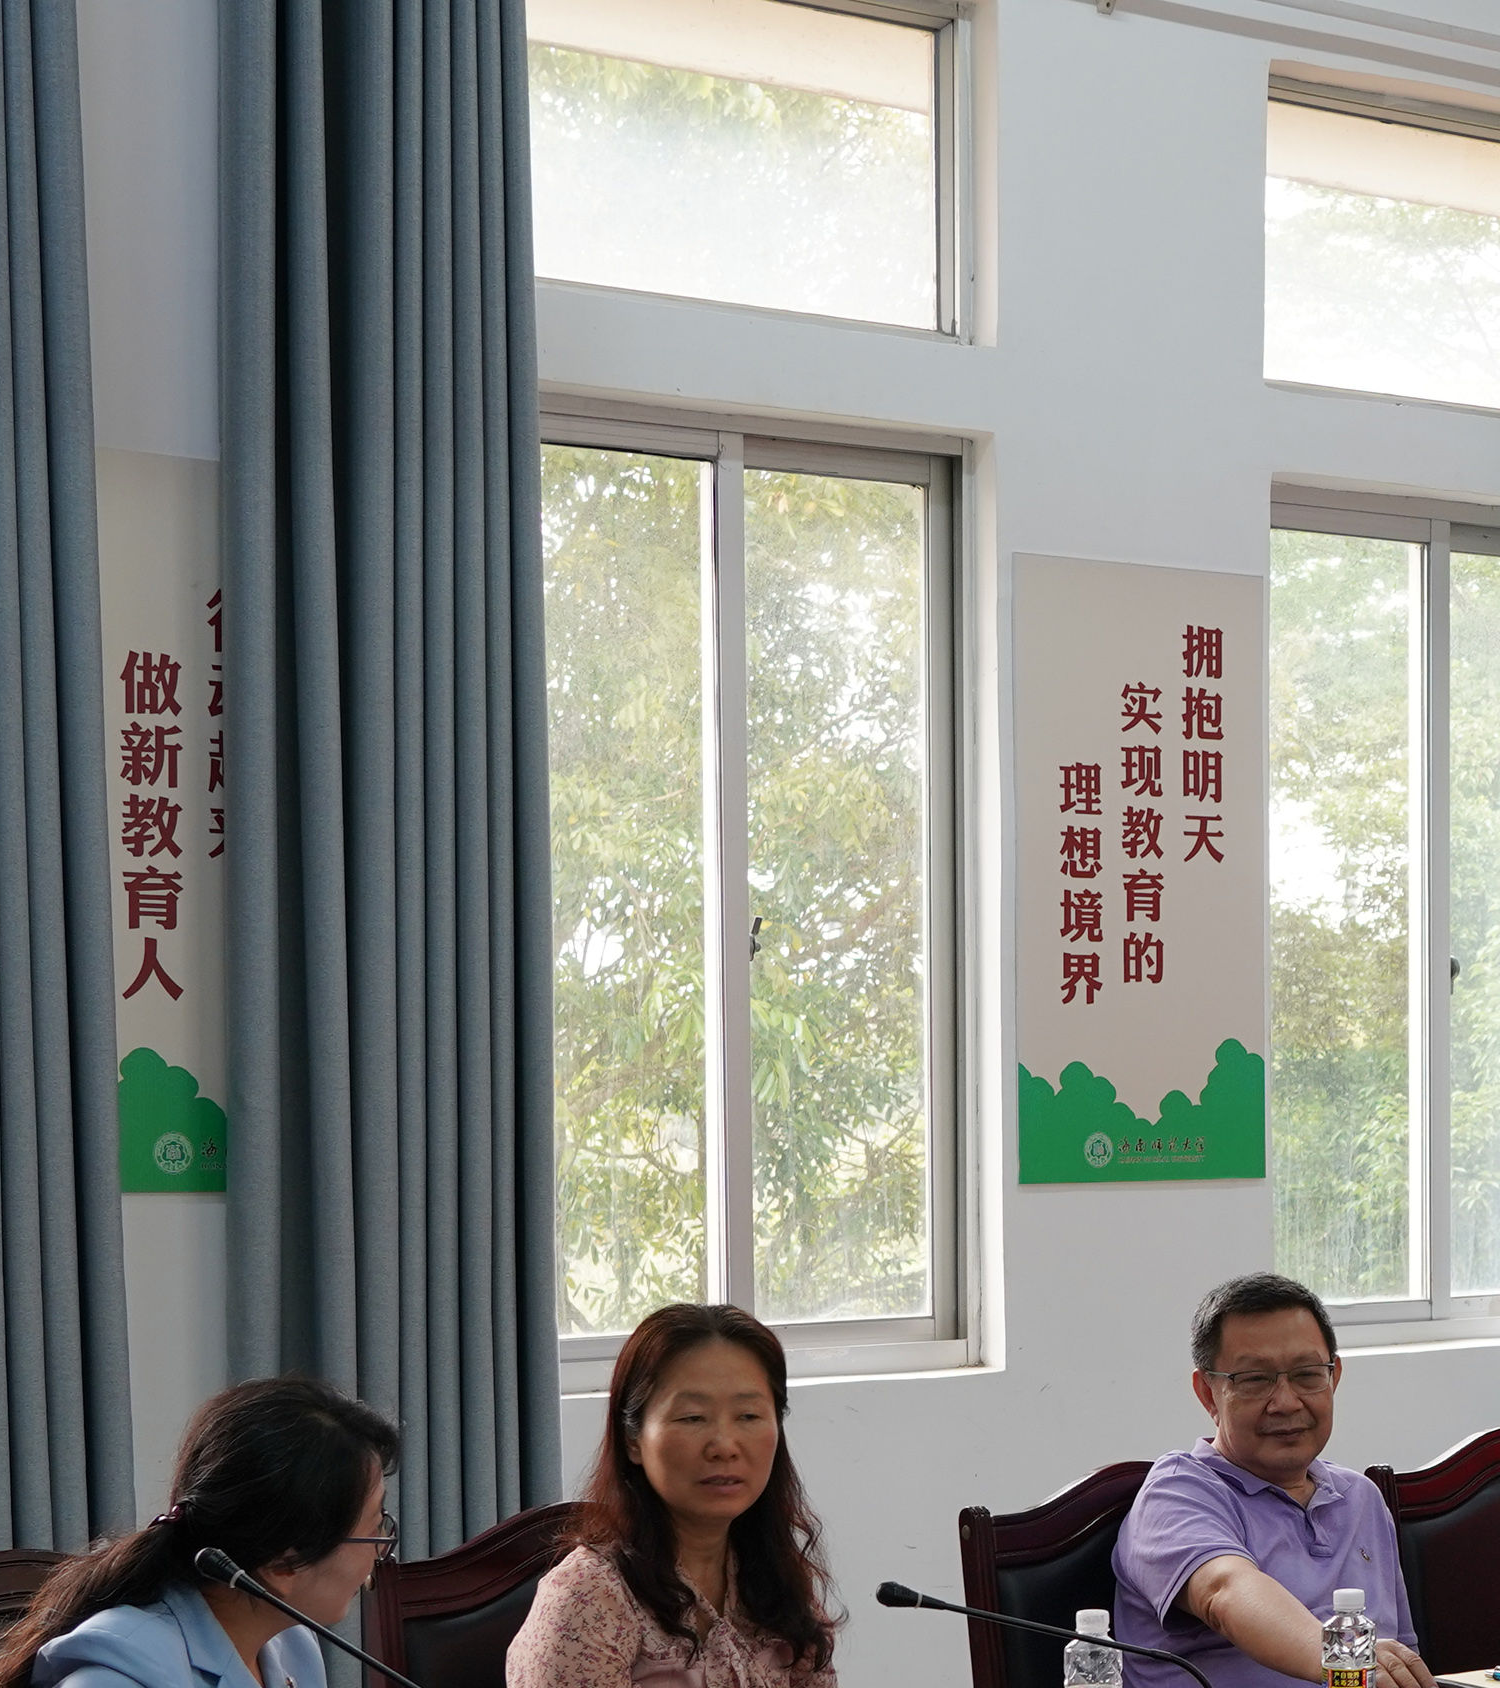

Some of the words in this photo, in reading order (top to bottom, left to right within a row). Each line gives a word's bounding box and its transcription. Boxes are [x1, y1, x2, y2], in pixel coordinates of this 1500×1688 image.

[120, 650, 184, 1001] 做新教育人
[1121, 682, 1164, 985] 实现教育的
[1182, 625, 1224, 864] 拥抱明天
[1059, 761, 1103, 1005] 理想境界
